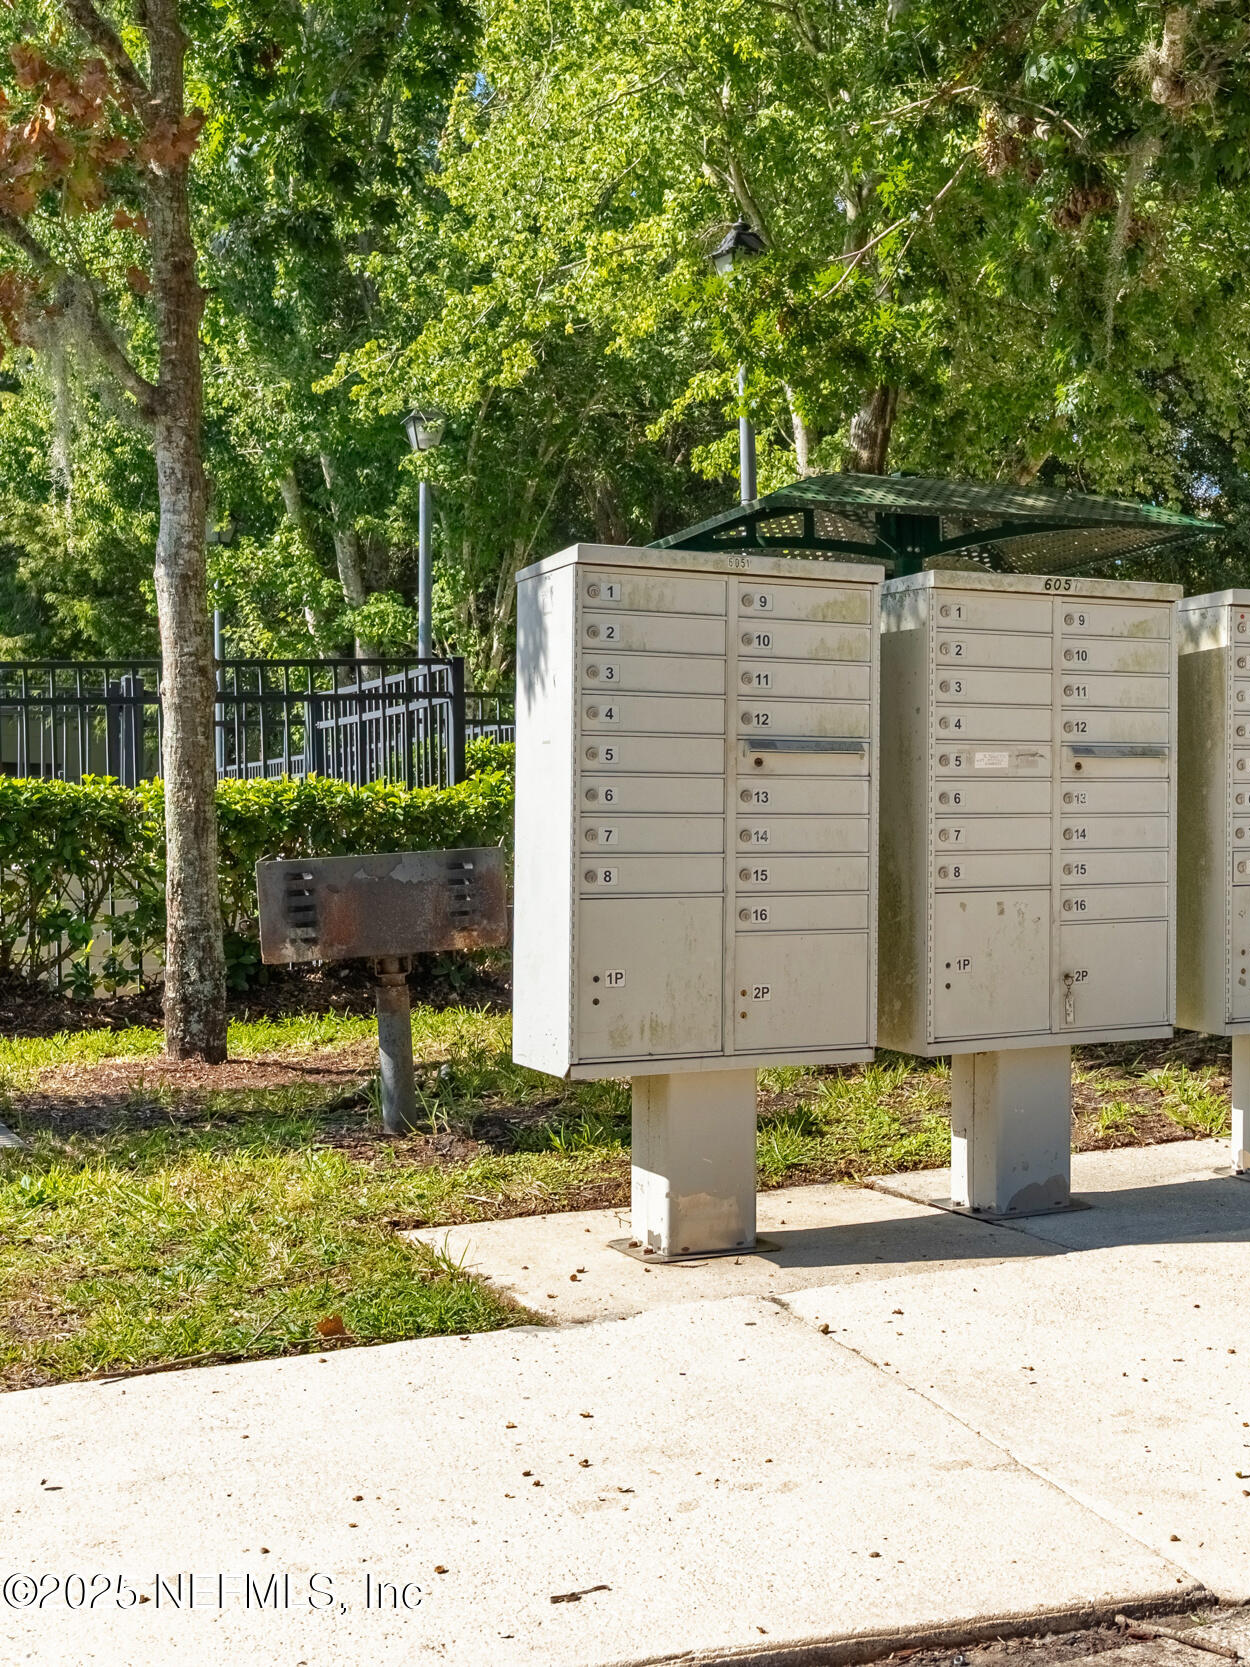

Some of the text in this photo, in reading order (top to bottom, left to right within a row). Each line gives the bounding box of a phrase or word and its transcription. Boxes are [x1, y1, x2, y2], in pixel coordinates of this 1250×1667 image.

[608, 586, 613, 597] 1
[760, 596, 767, 607] 9
[956, 607, 962, 618] 1
[1079, 615, 1085, 625] 9
[607, 627, 614, 638] 2
[756, 635, 770, 646] 10
[956, 645, 962, 655] 2
[1076, 650, 1087, 661] 10
[606, 667, 613, 679] 3
[756, 674, 768, 685] 11
[955, 682, 961, 692] 3
[1076, 686, 1086, 696] 11
[605, 708, 613, 719] 4
[755, 714, 768, 725] 12
[955, 719, 961, 729] 4
[1075, 722, 1086, 732] 12
[606, 749, 613, 760] 5
[955, 756, 961, 767] 5
[605, 789, 613, 801] 6
[755, 792, 768, 803] 13
[954, 793, 960, 804] 6
[605, 830, 612, 842] 7
[754, 831, 768, 842] 14
[955, 830, 960, 840] 7
[1075, 829, 1086, 839] 14
[954, 867, 960, 877] 8
[1075, 864, 1086, 874] 15
[604, 871, 611, 882] 8
[754, 870, 767, 881] 15
[1074, 900, 1086, 911] 16
[753, 909, 767, 920] 16
[957, 959, 969, 970] 1P
[607, 972, 623, 984] 1P
[1076, 971, 1088, 981] 2P
[754, 987, 769, 999] 2P
